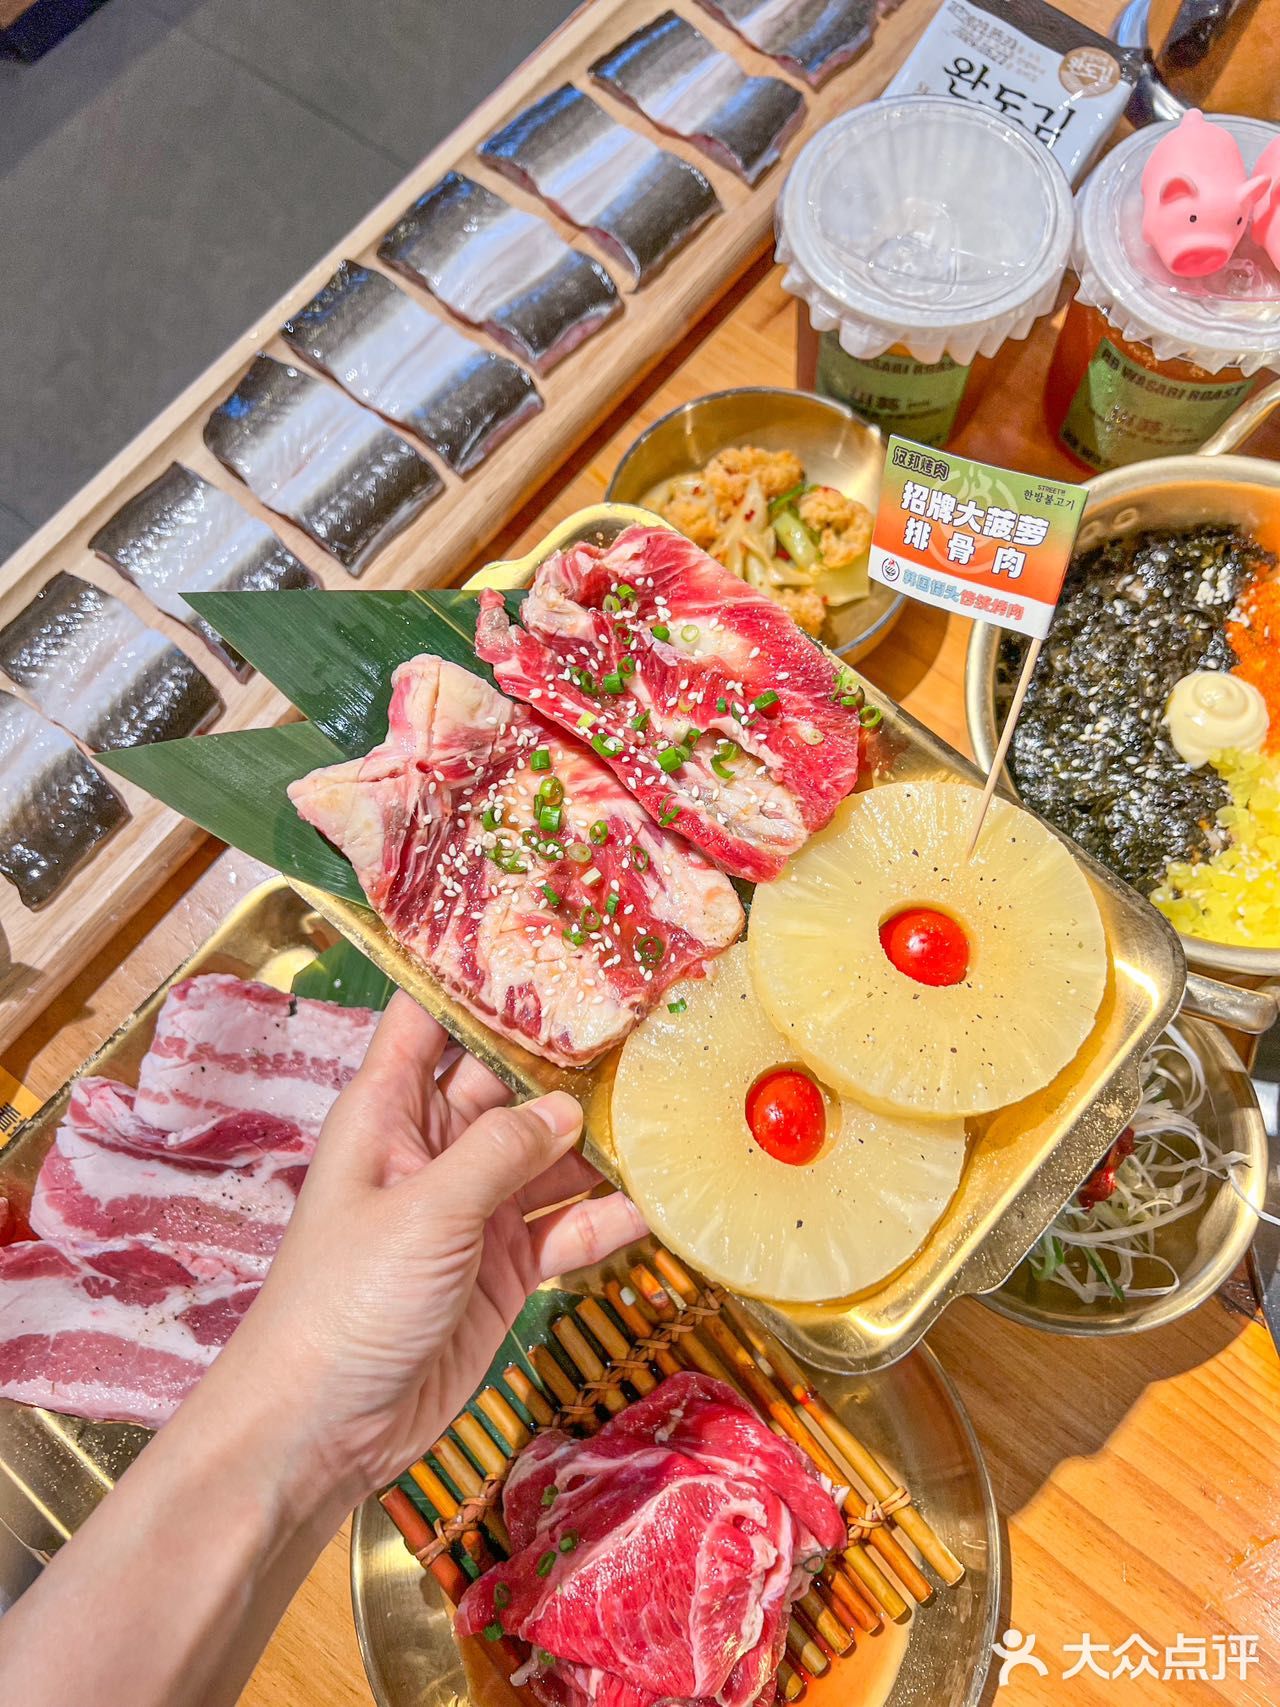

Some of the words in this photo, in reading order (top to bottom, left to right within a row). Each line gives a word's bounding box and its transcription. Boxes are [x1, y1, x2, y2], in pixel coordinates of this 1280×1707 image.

[893, 446, 949, 480] 汉邦烤肉
[901, 480, 1050, 547] 招牌大菠萝
[1023, 488, 1075, 511] 한방불고기
